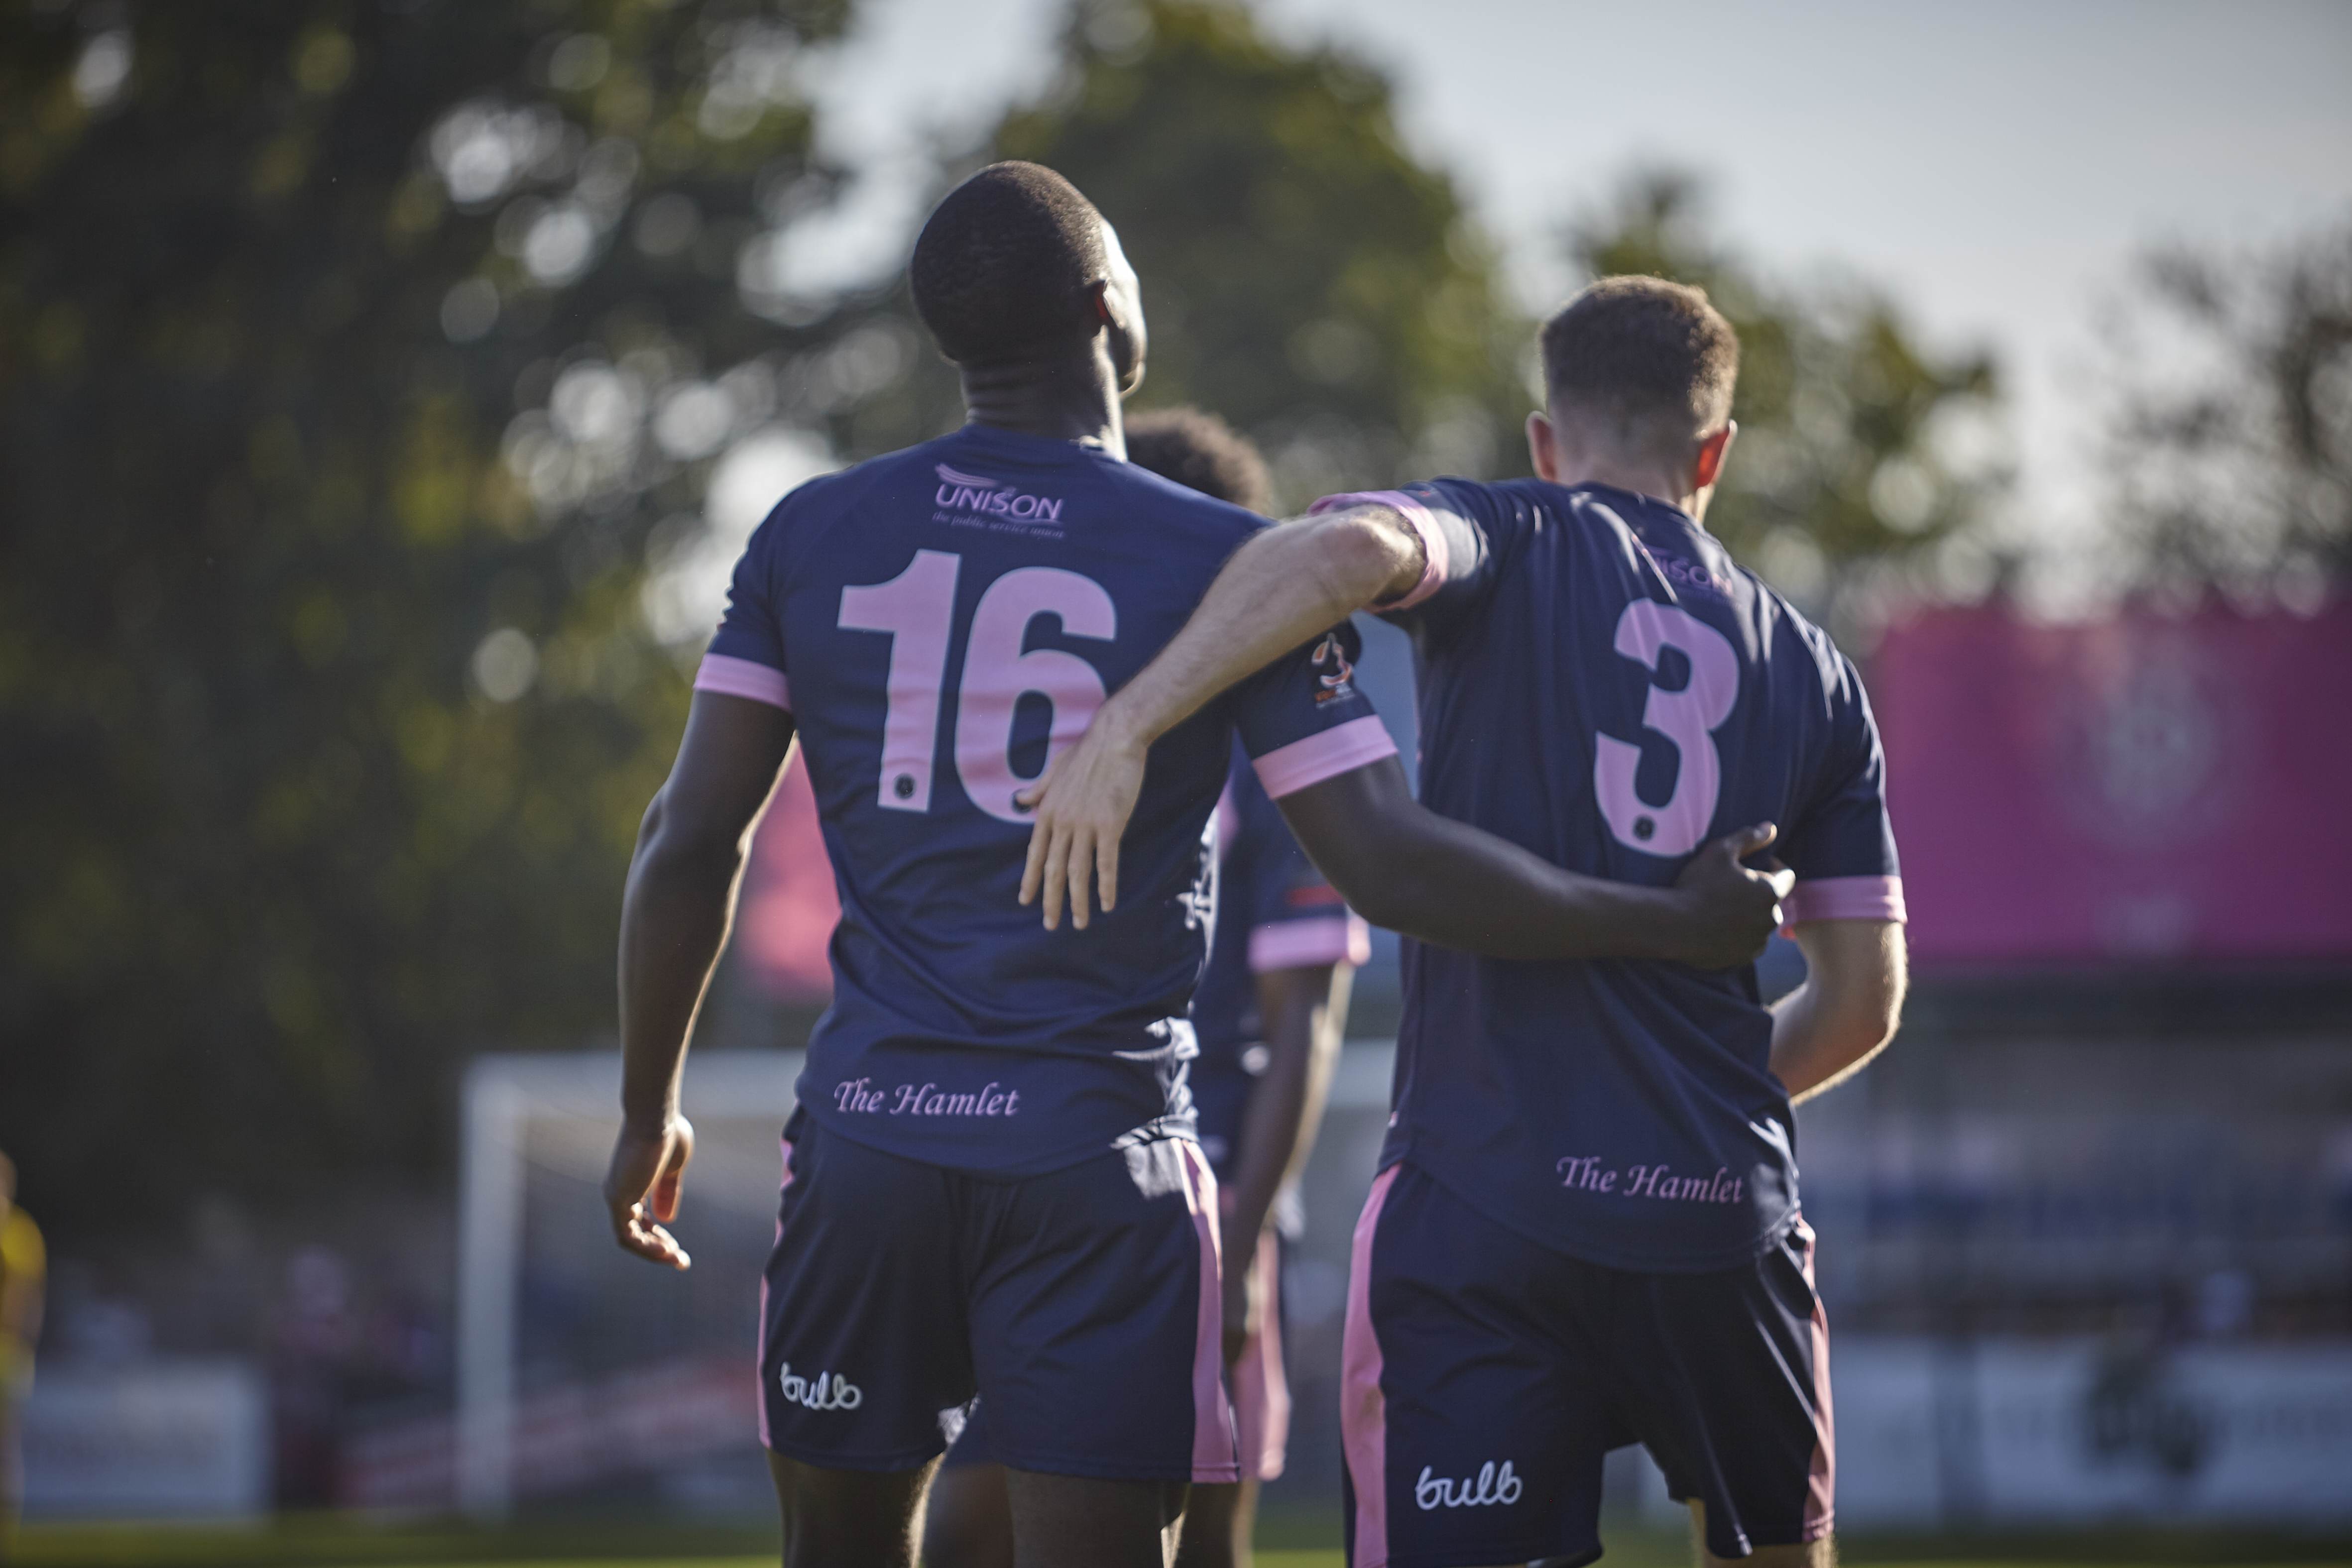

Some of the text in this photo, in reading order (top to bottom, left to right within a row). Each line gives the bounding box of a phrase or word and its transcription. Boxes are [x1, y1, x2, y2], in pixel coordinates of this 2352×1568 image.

[935, 483, 1064, 520] UNISON
[1651, 556, 1734, 597] ISON
[837, 548, 1116, 824] 16
[1594, 597, 1740, 858] 3
[833, 1076, 1021, 1117] The Hamlet
[1555, 1155, 1743, 1205] The Hamlet
[779, 1360, 863, 1411] bulb
[1414, 1459, 1524, 1511] bulb
